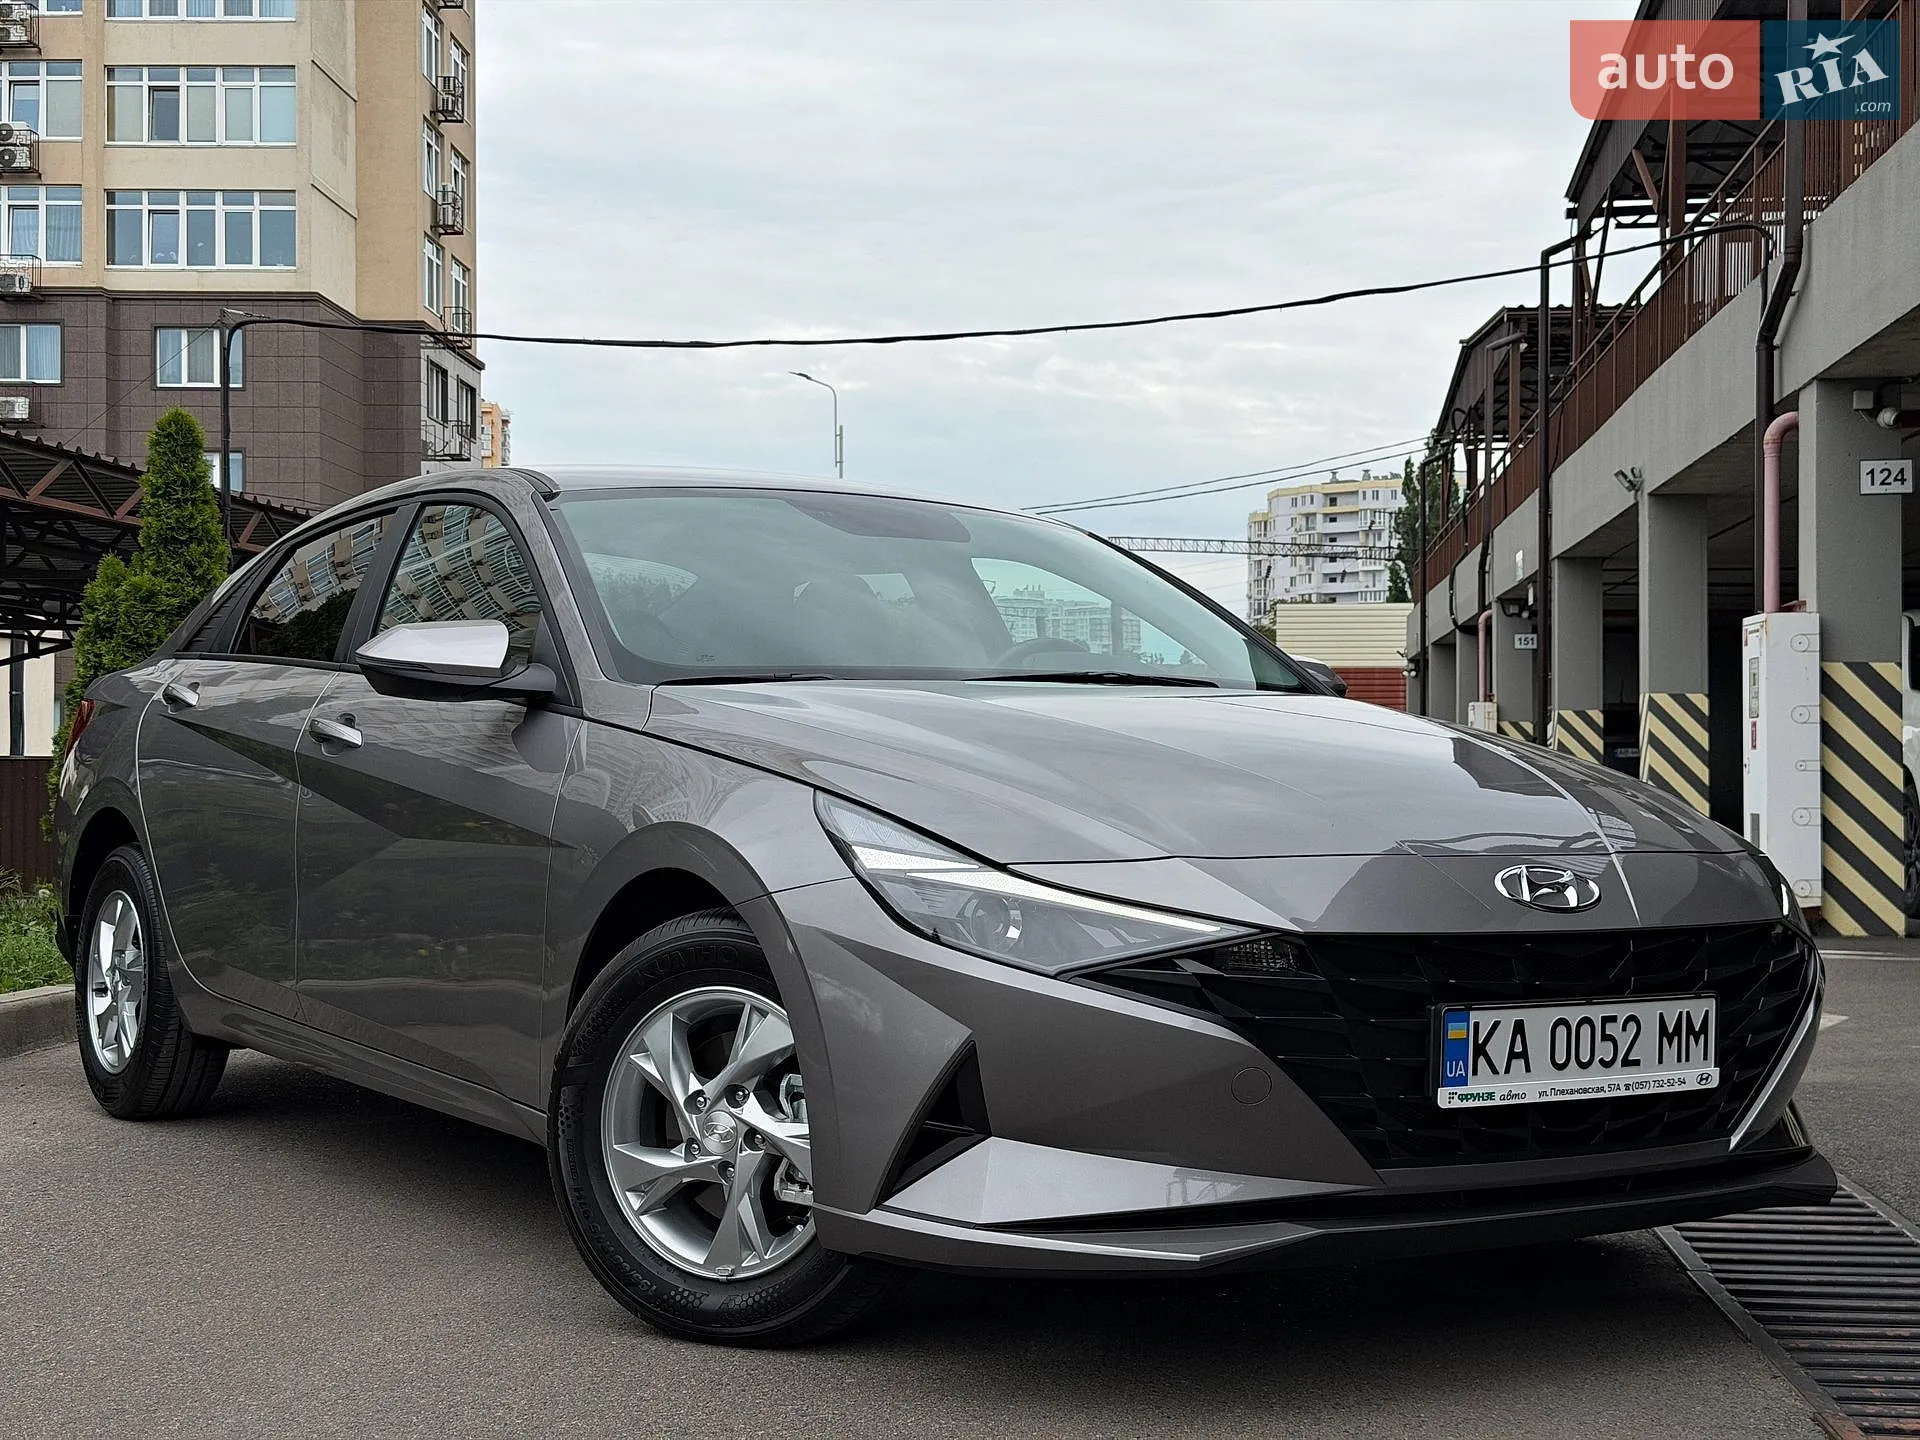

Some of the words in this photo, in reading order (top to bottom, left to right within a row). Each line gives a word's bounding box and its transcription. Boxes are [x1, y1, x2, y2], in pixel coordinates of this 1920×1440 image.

[1866, 467, 1908, 486] 124
[1518, 636, 1535, 646] 151
[1471, 1018, 1532, 1077] KA
[1549, 1013, 1642, 1071] 0052
[1657, 1008, 1710, 1065] MM
[1446, 1059, 1466, 1078] UA
[1457, 1091, 1496, 1103] ФРУНЗЕ
[1498, 1089, 1527, 1101] авто
